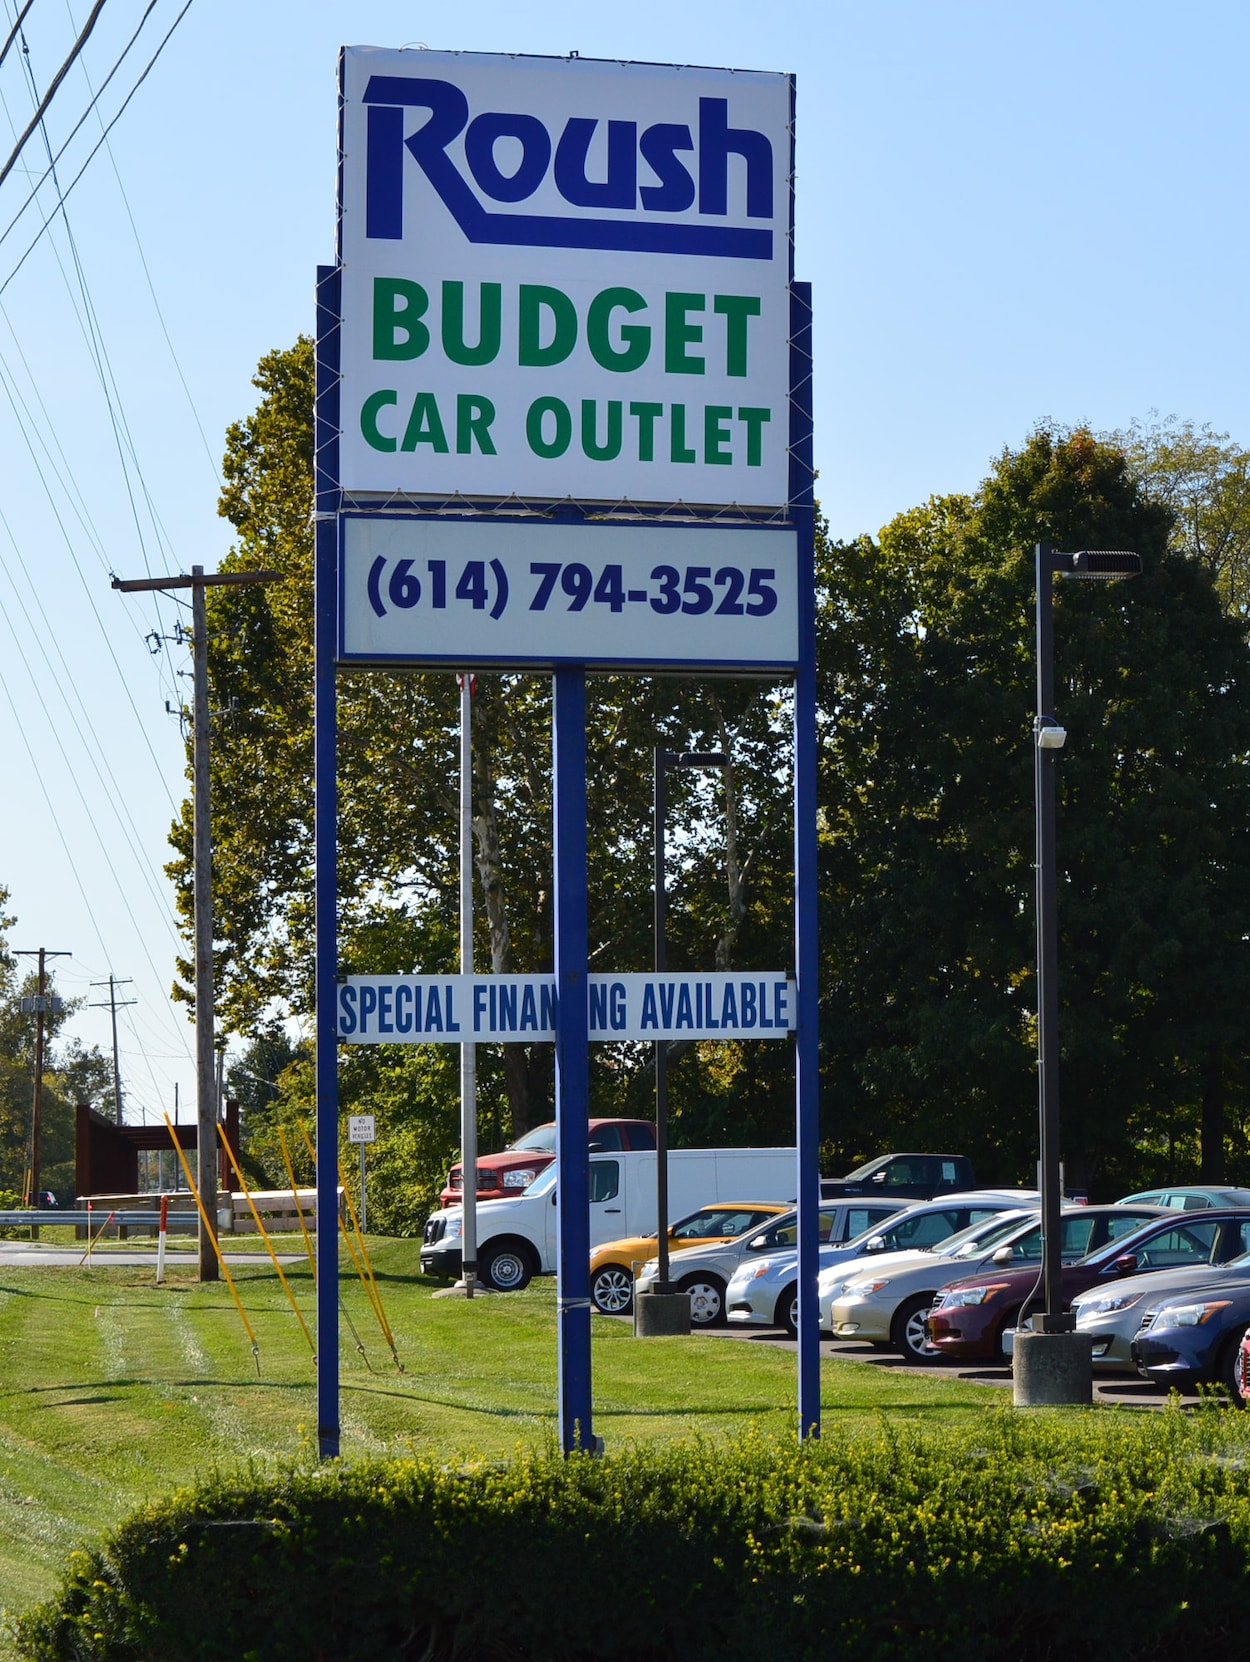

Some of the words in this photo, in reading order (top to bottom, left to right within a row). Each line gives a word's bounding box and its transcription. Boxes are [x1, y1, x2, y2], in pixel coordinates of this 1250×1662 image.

[361, 75, 774, 260] Roush
[373, 277, 762, 378] BUDGET
[360, 389, 498, 456] CAR
[526, 396, 772, 468] OUTLET
[367, 554, 509, 621] (614)
[528, 562, 779, 618] 794-3525
[339, 985, 461, 1034] SPECIAL
[473, 982, 626, 1032] FINANNG
[640, 982, 790, 1030] AVAILABLE
